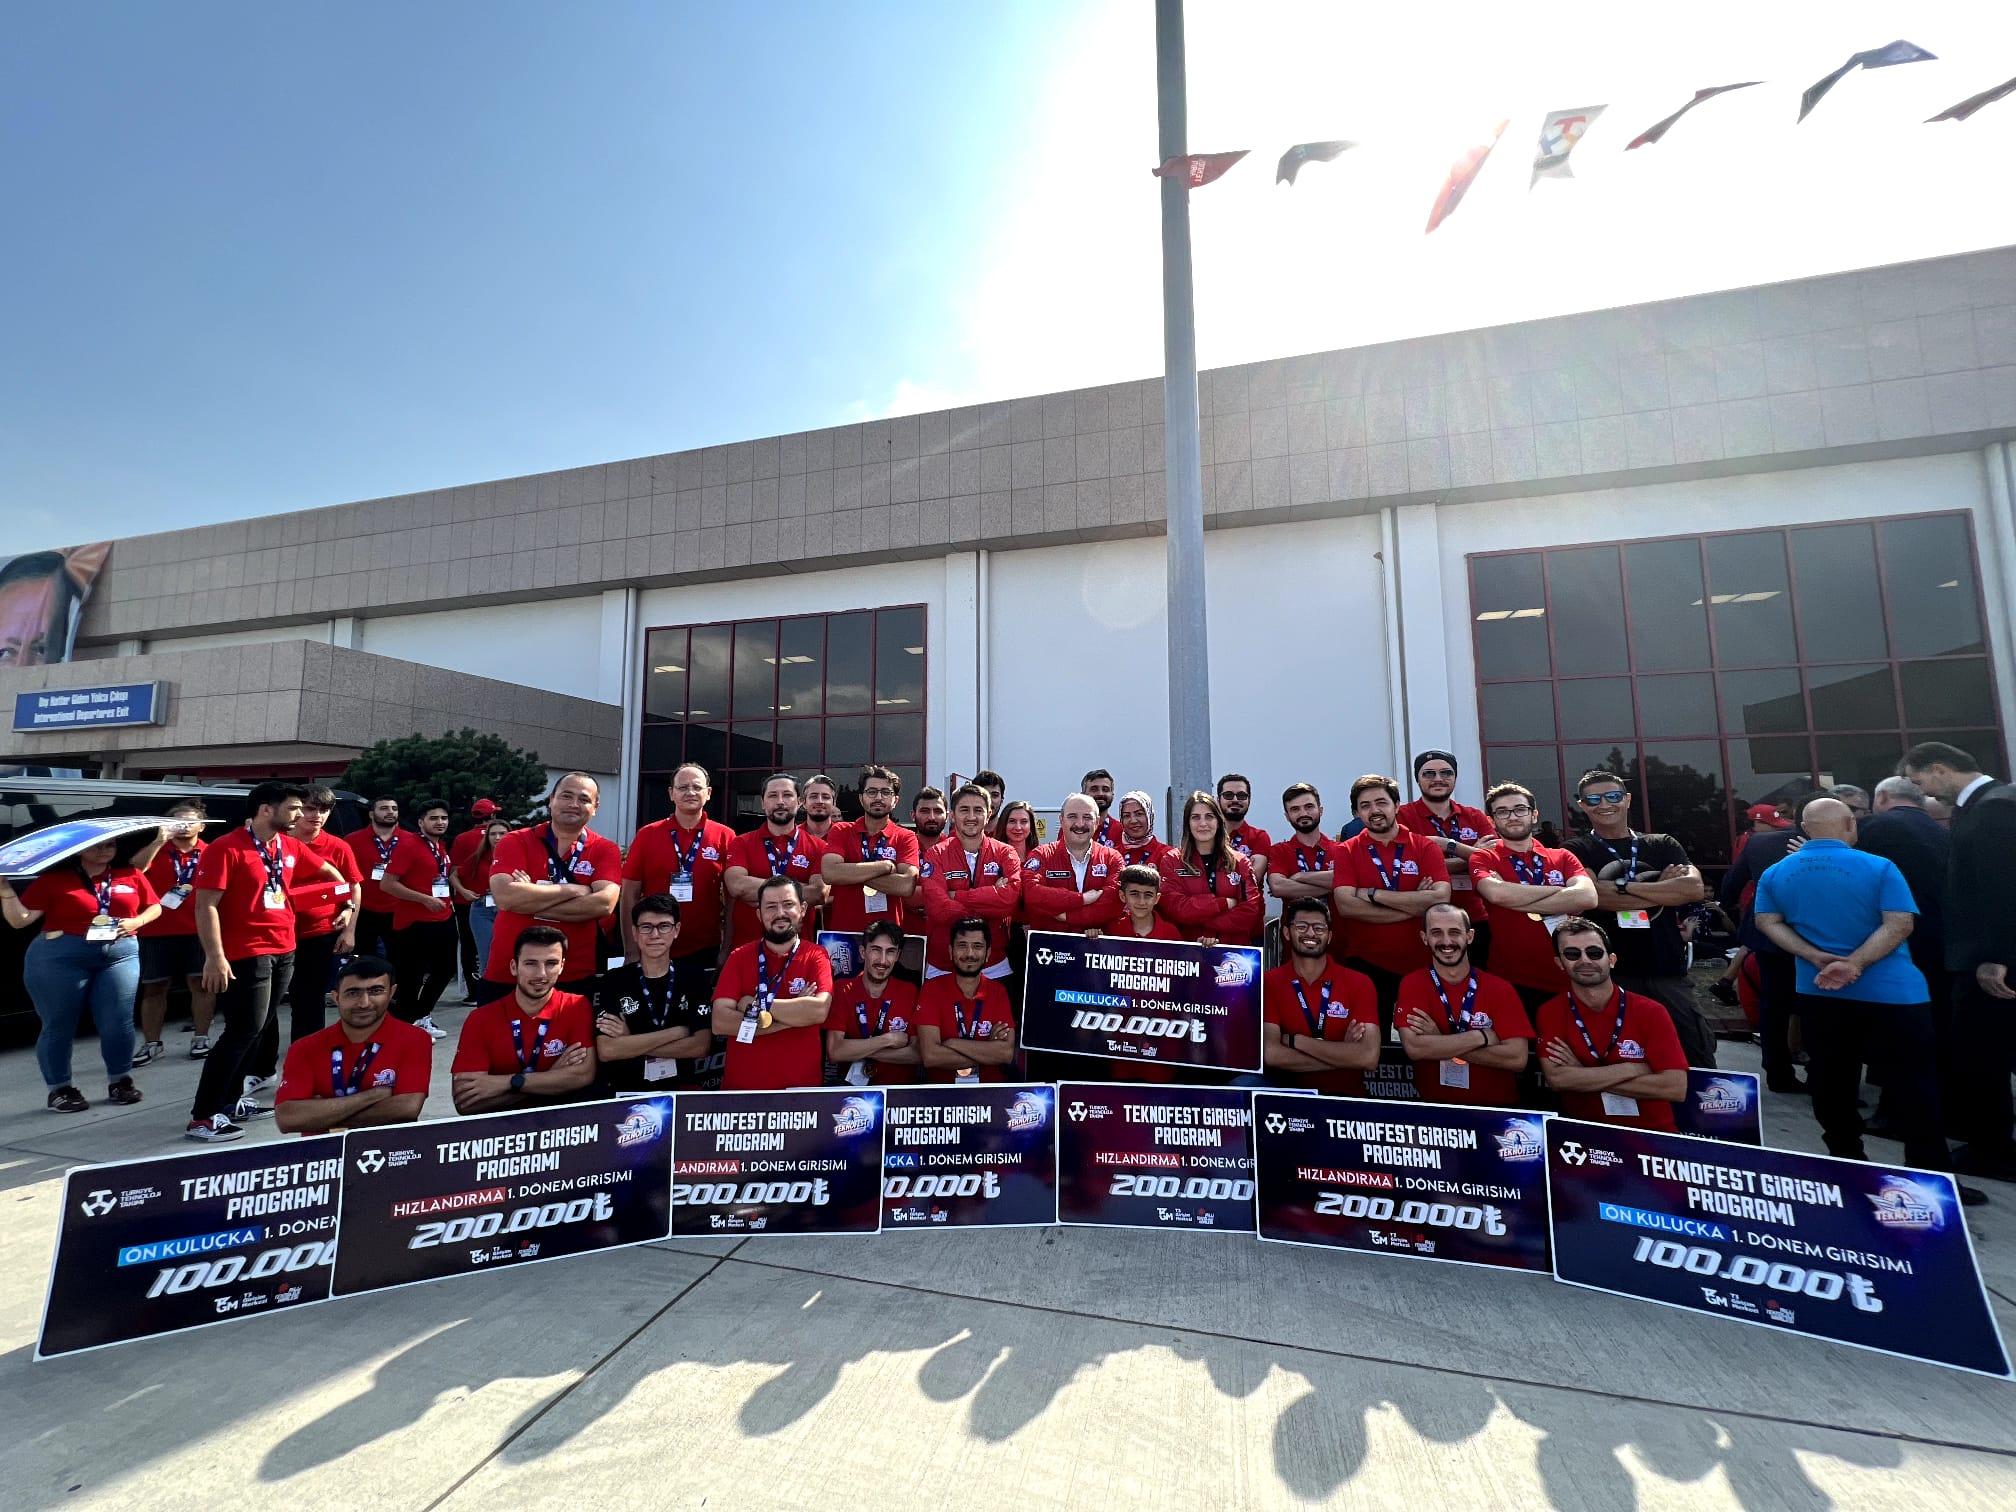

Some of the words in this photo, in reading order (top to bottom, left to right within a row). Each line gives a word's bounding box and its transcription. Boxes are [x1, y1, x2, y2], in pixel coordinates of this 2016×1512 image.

[116, 707, 129, 717] Exit
[1085, 953, 1153, 973] TEKNOFEST
[1110, 973, 1170, 992] PROGRAMI
[1132, 999, 1138, 1007] 1.
[686, 1113, 765, 1131] TEKNOFEST
[768, 1112, 817, 1130] GİRİŞİM
[943, 1106, 992, 1124] GİRİŞİM
[1124, 1105, 1199, 1125] TEKNOFEST
[437, 1131, 537, 1164] TEKNOFEST
[540, 1124, 598, 1147] GİRİŞİM
[716, 1133, 784, 1151] PROGRAMI
[895, 1127, 960, 1145] PROGRAMI
[1155, 1126, 1222, 1147] PROGRAMI
[1326, 1119, 1415, 1145] TEKNOFEST
[1418, 1126, 1477, 1149] GİRİŞİM
[919, 1156, 925, 1165] 1.
[1096, 1153, 1179, 1166] HIZLANDIRMA
[1181, 1156, 1188, 1167] 1.
[1363, 1144, 1442, 1169] PROGRAMI
[1499, 1145, 1542, 1158] TEKNOFEST
[476, 1151, 560, 1181] PROGRAMI
[741, 1163, 747, 1172] 1.
[181, 1163, 303, 1202] TEKNOFEST
[1109, 1174, 1255, 1201] 200.000
[1298, 1167, 1392, 1187] HIZLANDIRMA
[1395, 1176, 1403, 1188] 1.
[1637, 1154, 1756, 1194] TEKNOFEST
[1761, 1172, 1843, 1208] GİRİŞİM
[227, 1183, 329, 1220] PROGRAMI
[394, 1191, 504, 1216] HIZLANDIRMA
[508, 1187, 515, 1199] 1.
[1688, 1186, 1796, 1227] PROGRAMI
[1875, 1208, 1933, 1226] TEKNOFEST
[1636, 1211, 1725, 1240] KULUÇKA
[1732, 1229, 1744, 1244] 1.
[163, 1230, 255, 1261] KULUÇKA
[264, 1227, 273, 1240] 1.
